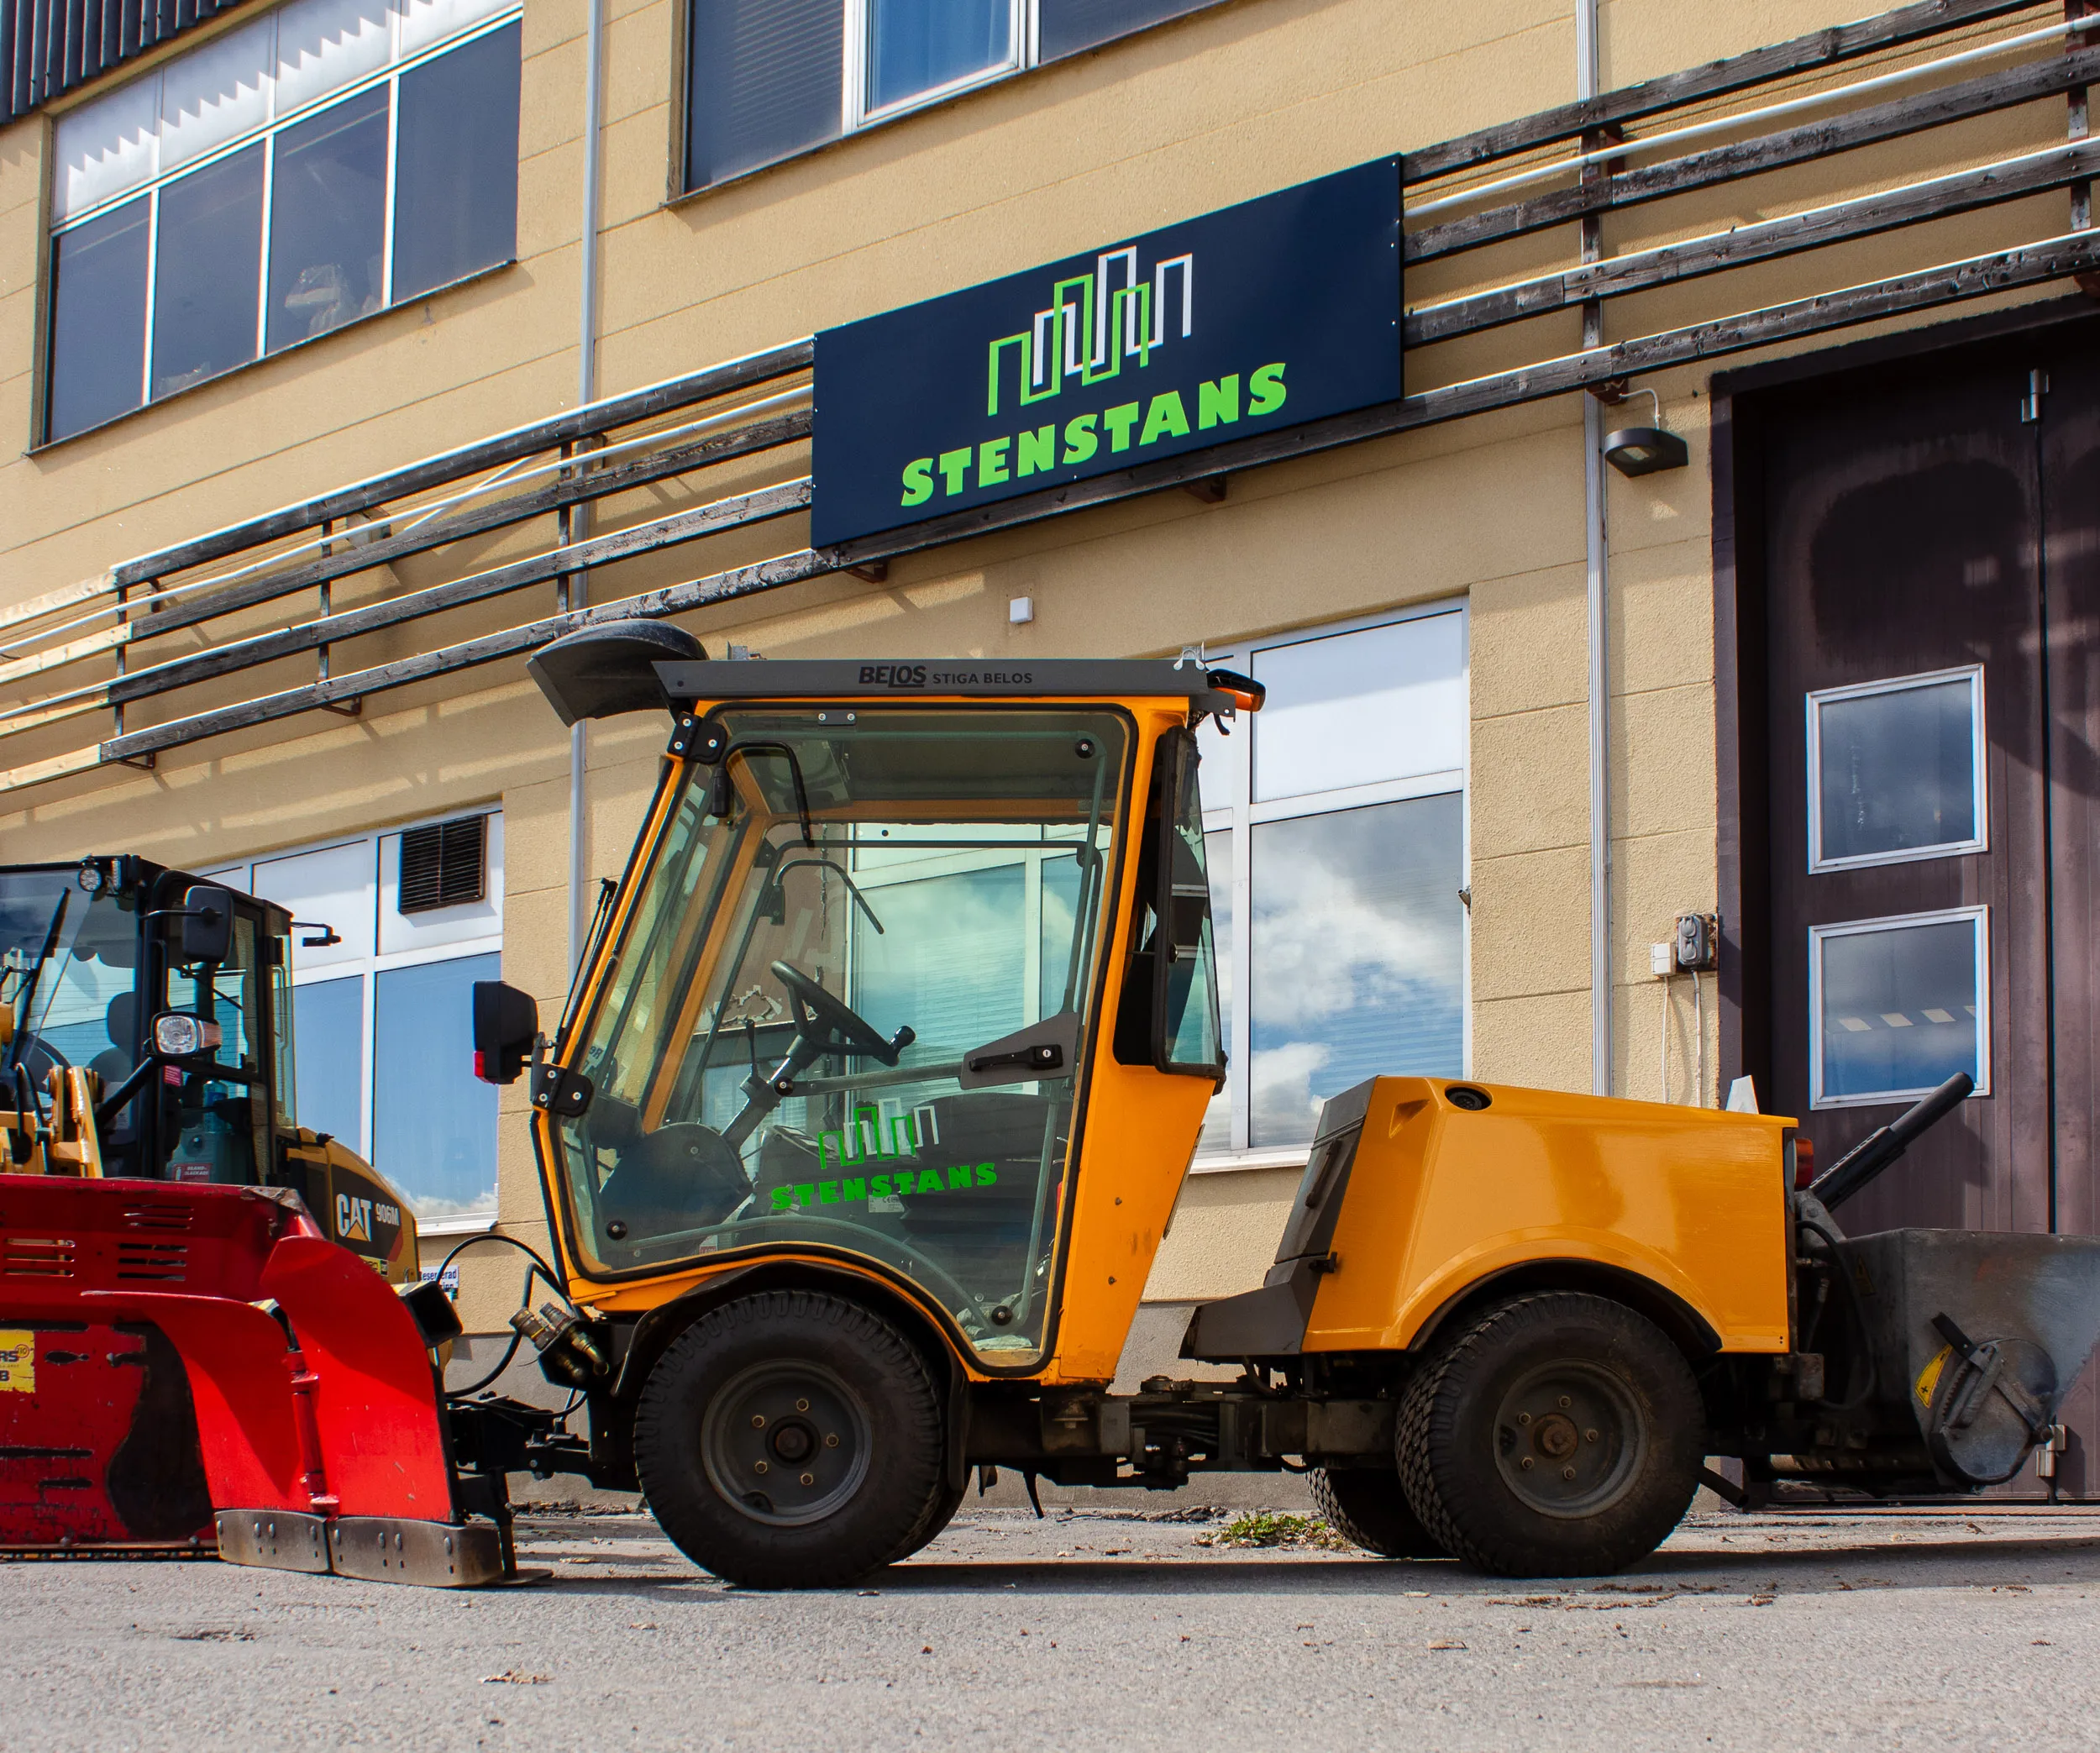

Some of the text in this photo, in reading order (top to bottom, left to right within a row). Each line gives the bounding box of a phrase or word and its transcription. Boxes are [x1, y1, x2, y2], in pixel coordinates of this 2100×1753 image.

[901, 363, 1287, 506] STENSTANS
[858, 665, 1032, 688] BELOS STIGA BELOS
[771, 1163, 998, 1210] STENSTANS
[337, 1194, 399, 1242] CAT 906M
